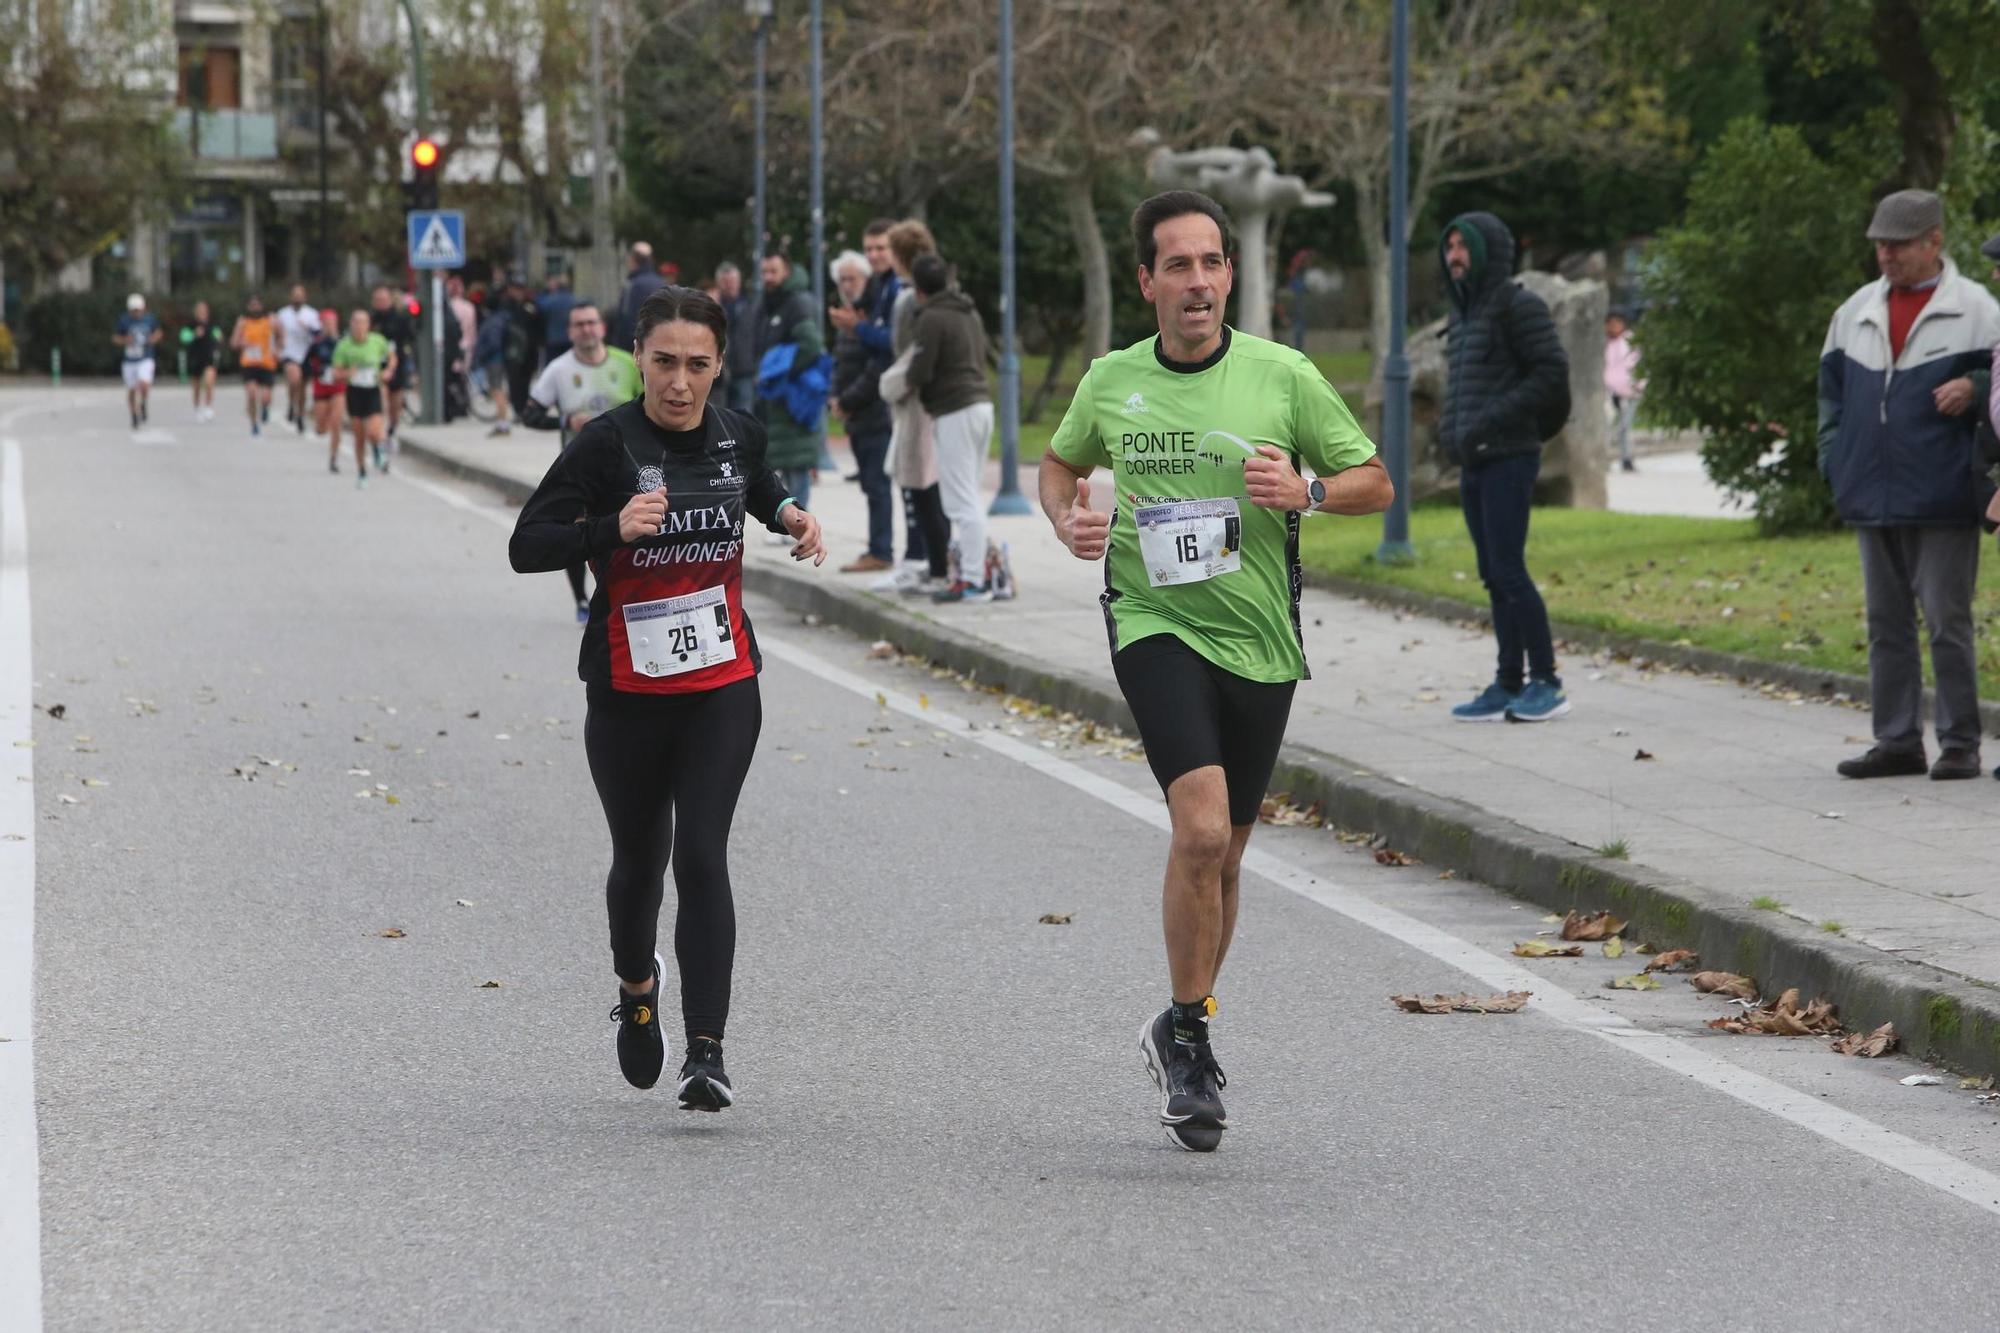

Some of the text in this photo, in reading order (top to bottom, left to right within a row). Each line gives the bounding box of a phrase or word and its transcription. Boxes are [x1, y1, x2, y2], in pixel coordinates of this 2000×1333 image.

[1122, 432, 1196, 454] PONTE
[1125, 459, 1196, 475] CORRER
[1150, 508, 1172, 517] TROFEO
[1173, 501, 1232, 514] PEDESTRISMO
[732, 520, 742, 537] &
[632, 539, 742, 568] CHUVONERS
[1175, 534, 1199, 563] 16
[643, 603, 666, 613] TROFEO
[668, 625, 698, 655] 26
